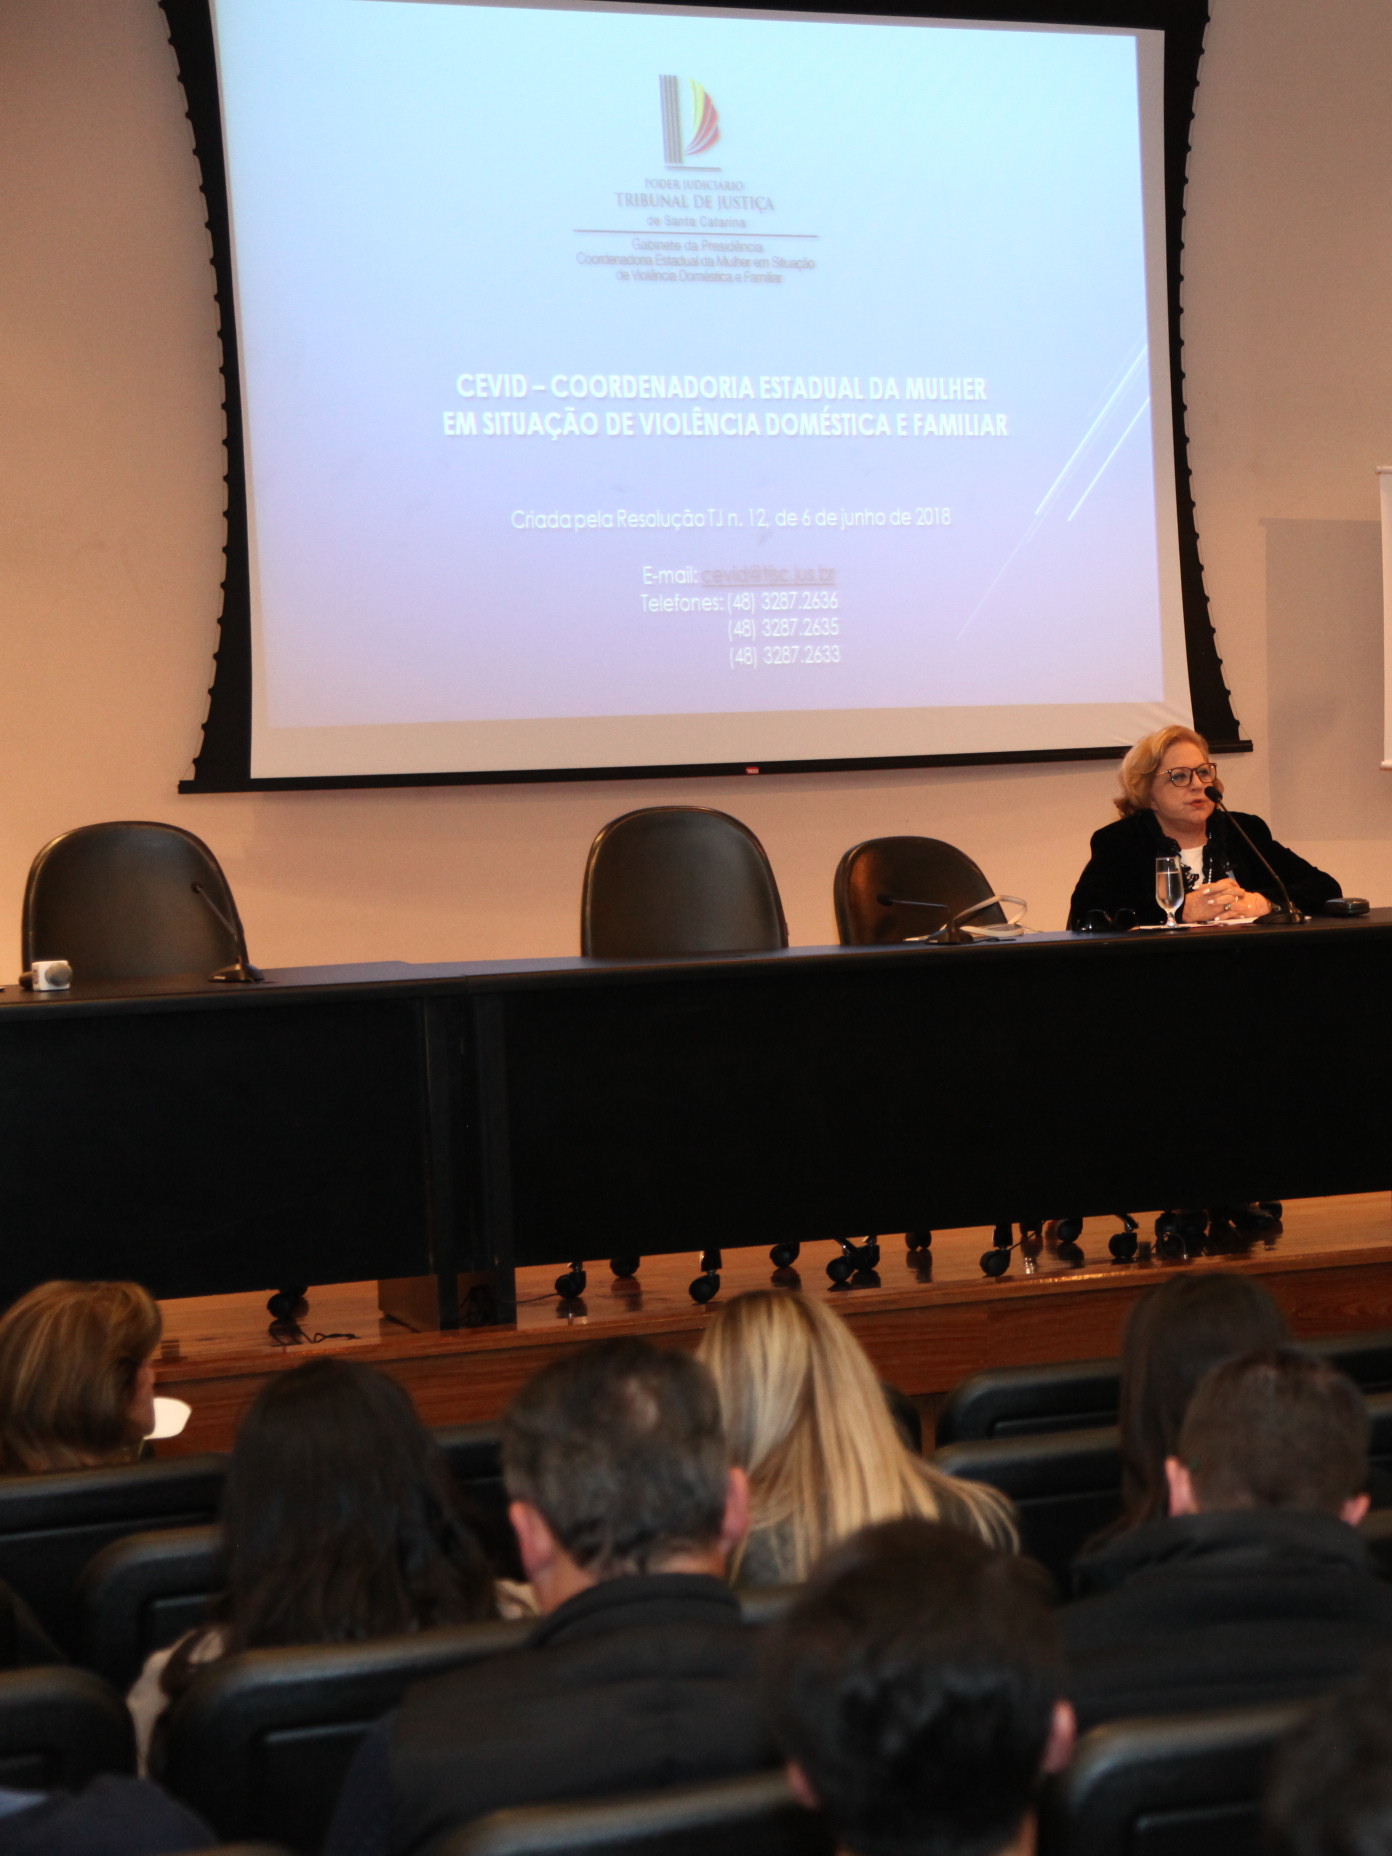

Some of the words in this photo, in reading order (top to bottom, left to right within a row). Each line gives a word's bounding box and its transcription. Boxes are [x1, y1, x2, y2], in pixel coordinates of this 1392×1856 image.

[644, 178, 681, 191] PODER
[614, 192, 689, 209] TRIBUNAL
[693, 194, 712, 209] DE
[717, 195, 774, 213] JUSTIÇA
[646, 215, 660, 226] de
[664, 216, 696, 227] Santa
[699, 216, 747, 228] Catarina
[631, 238, 681, 251] Gabinete
[684, 240, 699, 251] da
[456, 374, 527, 398] CEVID
[550, 374, 754, 399] COORDENADORIA
[759, 376, 864, 400] ESTADUAL
[869, 377, 900, 400] DA
[906, 377, 987, 400] MULHER
[443, 411, 477, 436] EM
[482, 407, 598, 440] SITUAÇÃO
[606, 412, 634, 436] DE
[638, 406, 760, 436] VIOLÊNCIA
[766, 405, 891, 436] DOMÉSTICA
[897, 413, 908, 436] E
[913, 413, 1008, 436] FAMILIAR
[511, 510, 571, 529] Criada
[574, 510, 613, 532] pela
[616, 509, 705, 531] Resolução
[706, 508, 723, 528] TJ
[727, 511, 743, 527] n.
[748, 508, 769, 528] 12,
[775, 508, 798, 527] de
[801, 508, 811, 527] 6
[815, 508, 837, 527] de
[840, 508, 886, 531] junho
[889, 508, 912, 526] de
[915, 507, 951, 526] 2018
[642, 565, 698, 585] E-mail:
[640, 593, 724, 612] Telefones:
[727, 592, 755, 615] (48)
[761, 591, 839, 610] 3287.2636
[728, 619, 756, 642] (48)
[761, 617, 840, 637] 3287.2635
[729, 646, 757, 670] (48)
[763, 645, 841, 665] 3287.2633
